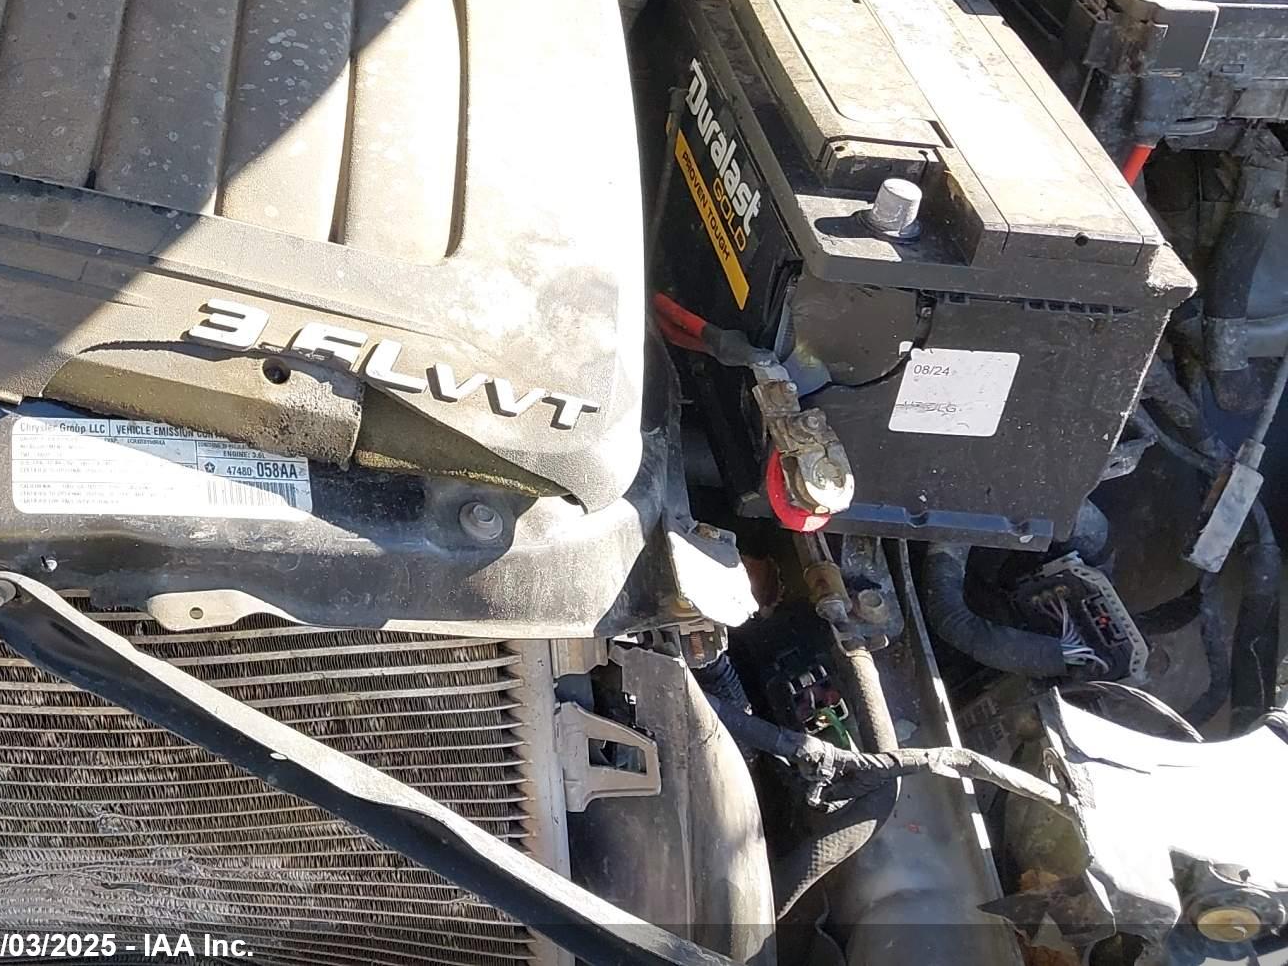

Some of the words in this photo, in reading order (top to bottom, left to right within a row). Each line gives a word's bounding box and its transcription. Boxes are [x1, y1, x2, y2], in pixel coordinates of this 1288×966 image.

[685, 57, 762, 237] Duralast
[682, 151, 709, 209] PROVEN
[707, 204, 731, 261] TOUGH
[713, 177, 747, 253] GOLD
[913, 364, 950, 376] 08/24
[433, 362, 602, 429] VVT
[59, 423, 87, 434] Group
[89, 423, 106, 434] LLC
[116, 424, 152, 436] VEHICLE
[153, 426, 194, 438] EMISSION
[223, 450, 251, 459] ENGINE:
[226, 465, 252, 476] 47480
[256, 462, 299, 478] 058AA
